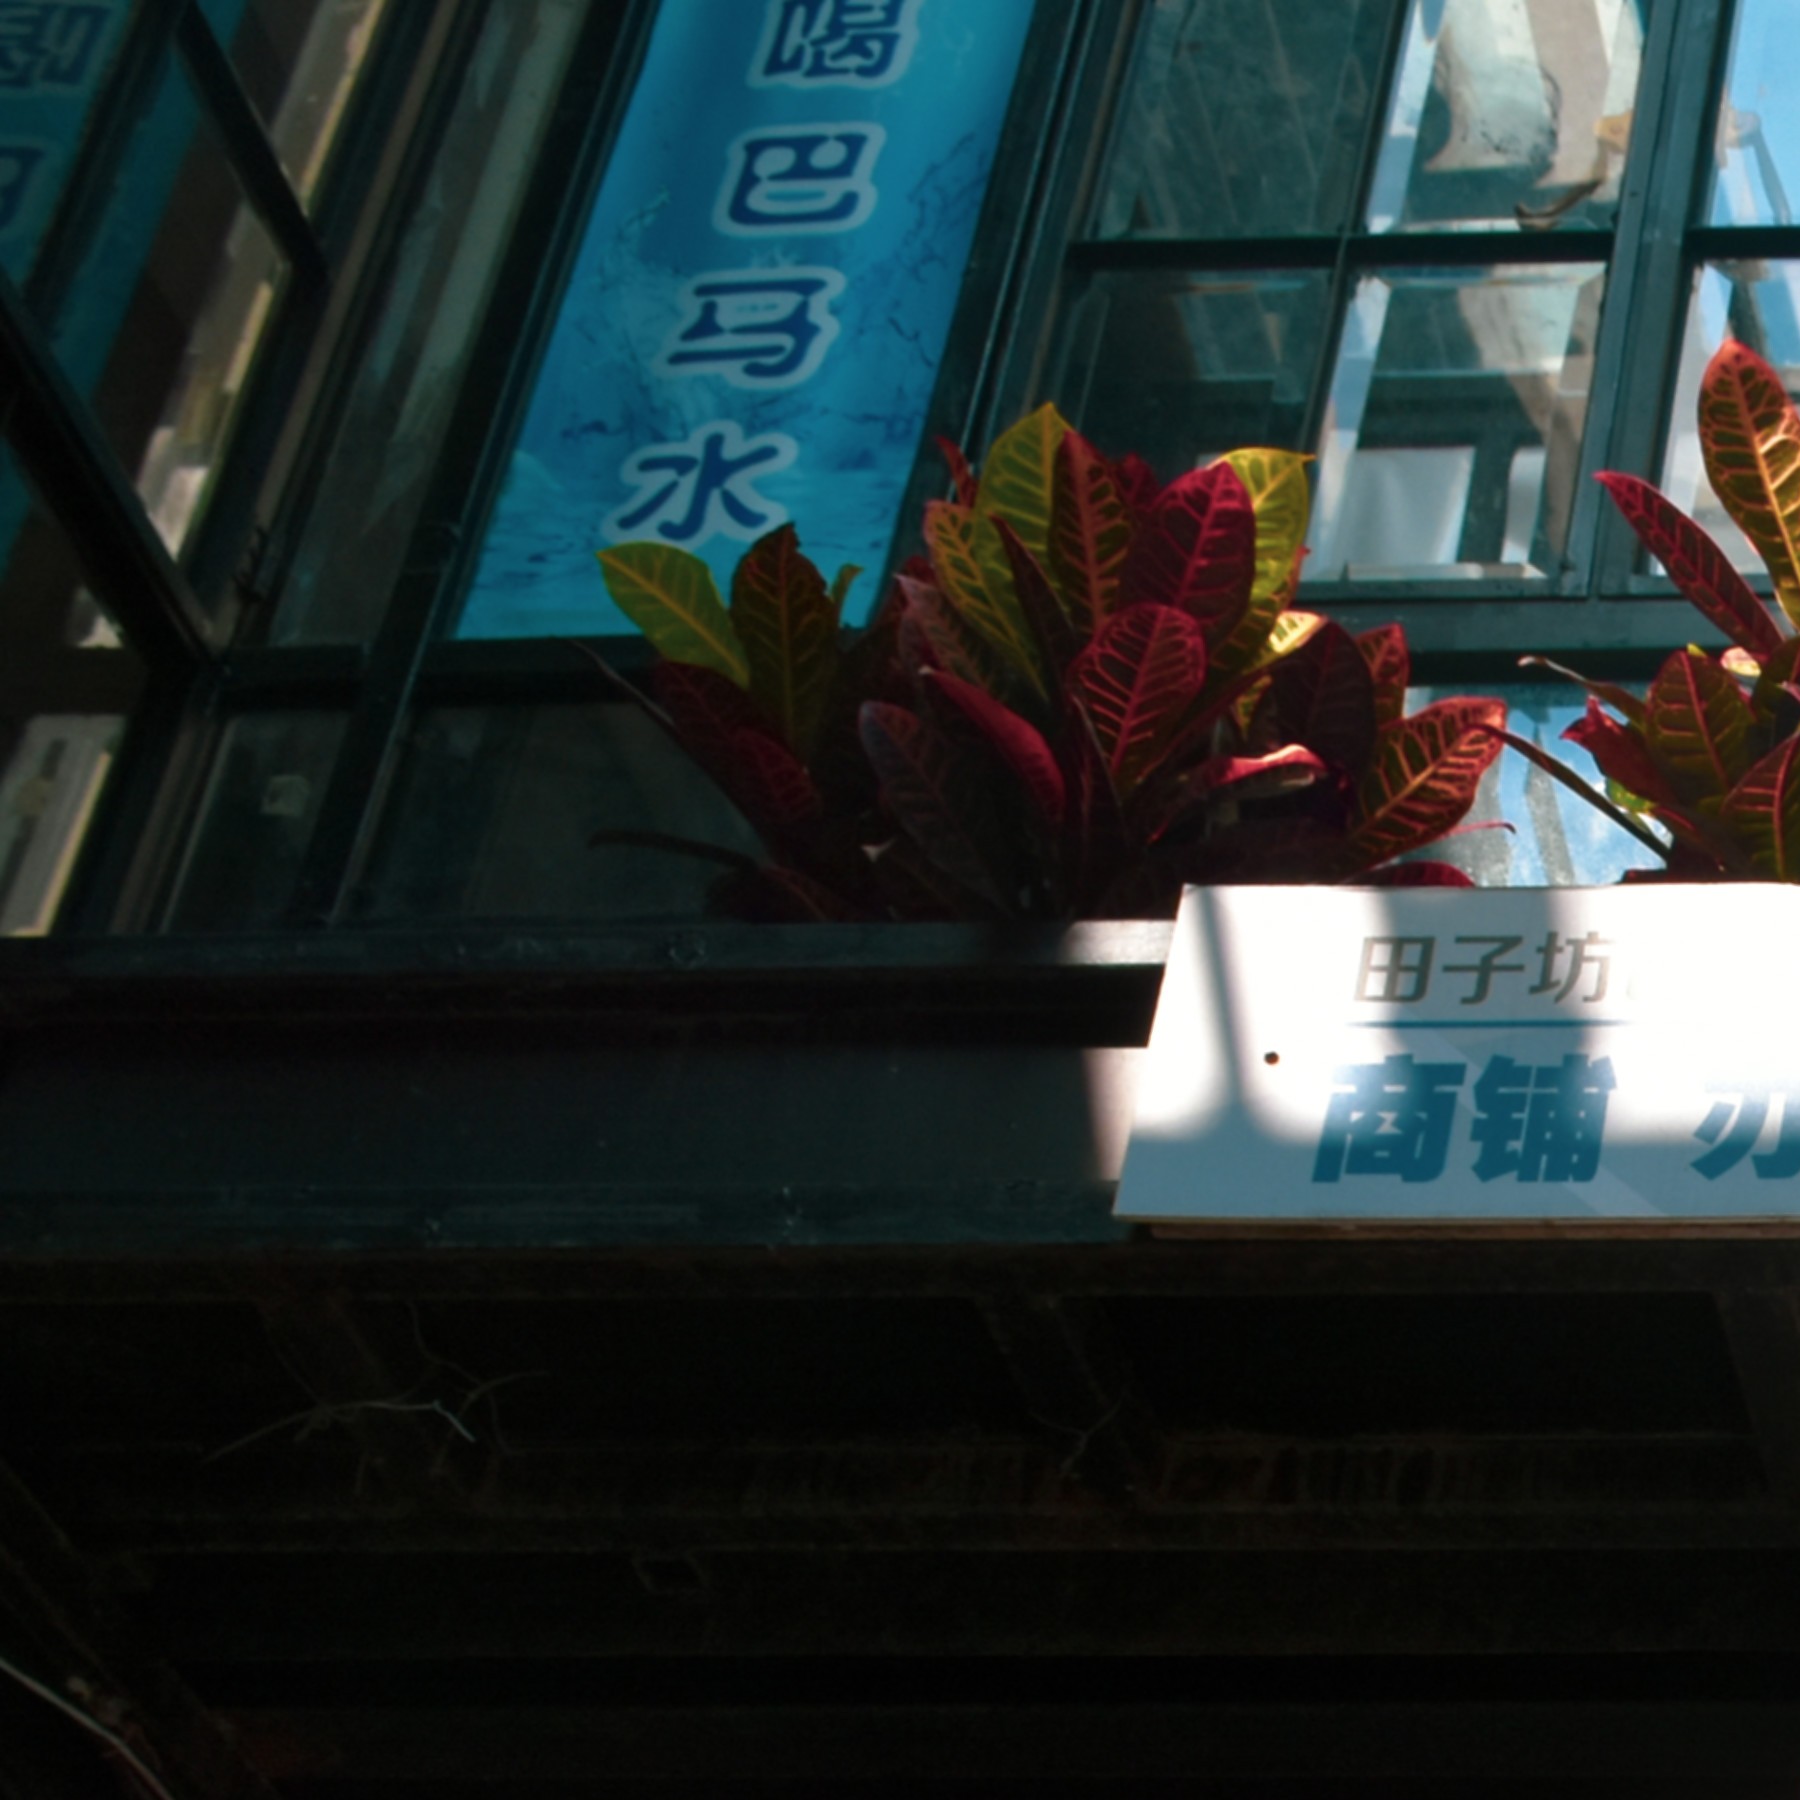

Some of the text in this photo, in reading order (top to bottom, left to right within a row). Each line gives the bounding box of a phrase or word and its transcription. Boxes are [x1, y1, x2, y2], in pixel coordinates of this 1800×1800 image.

[1352, 932, 1620, 1006] 田子坊
[1310, 1052, 1618, 1184] 商铺
